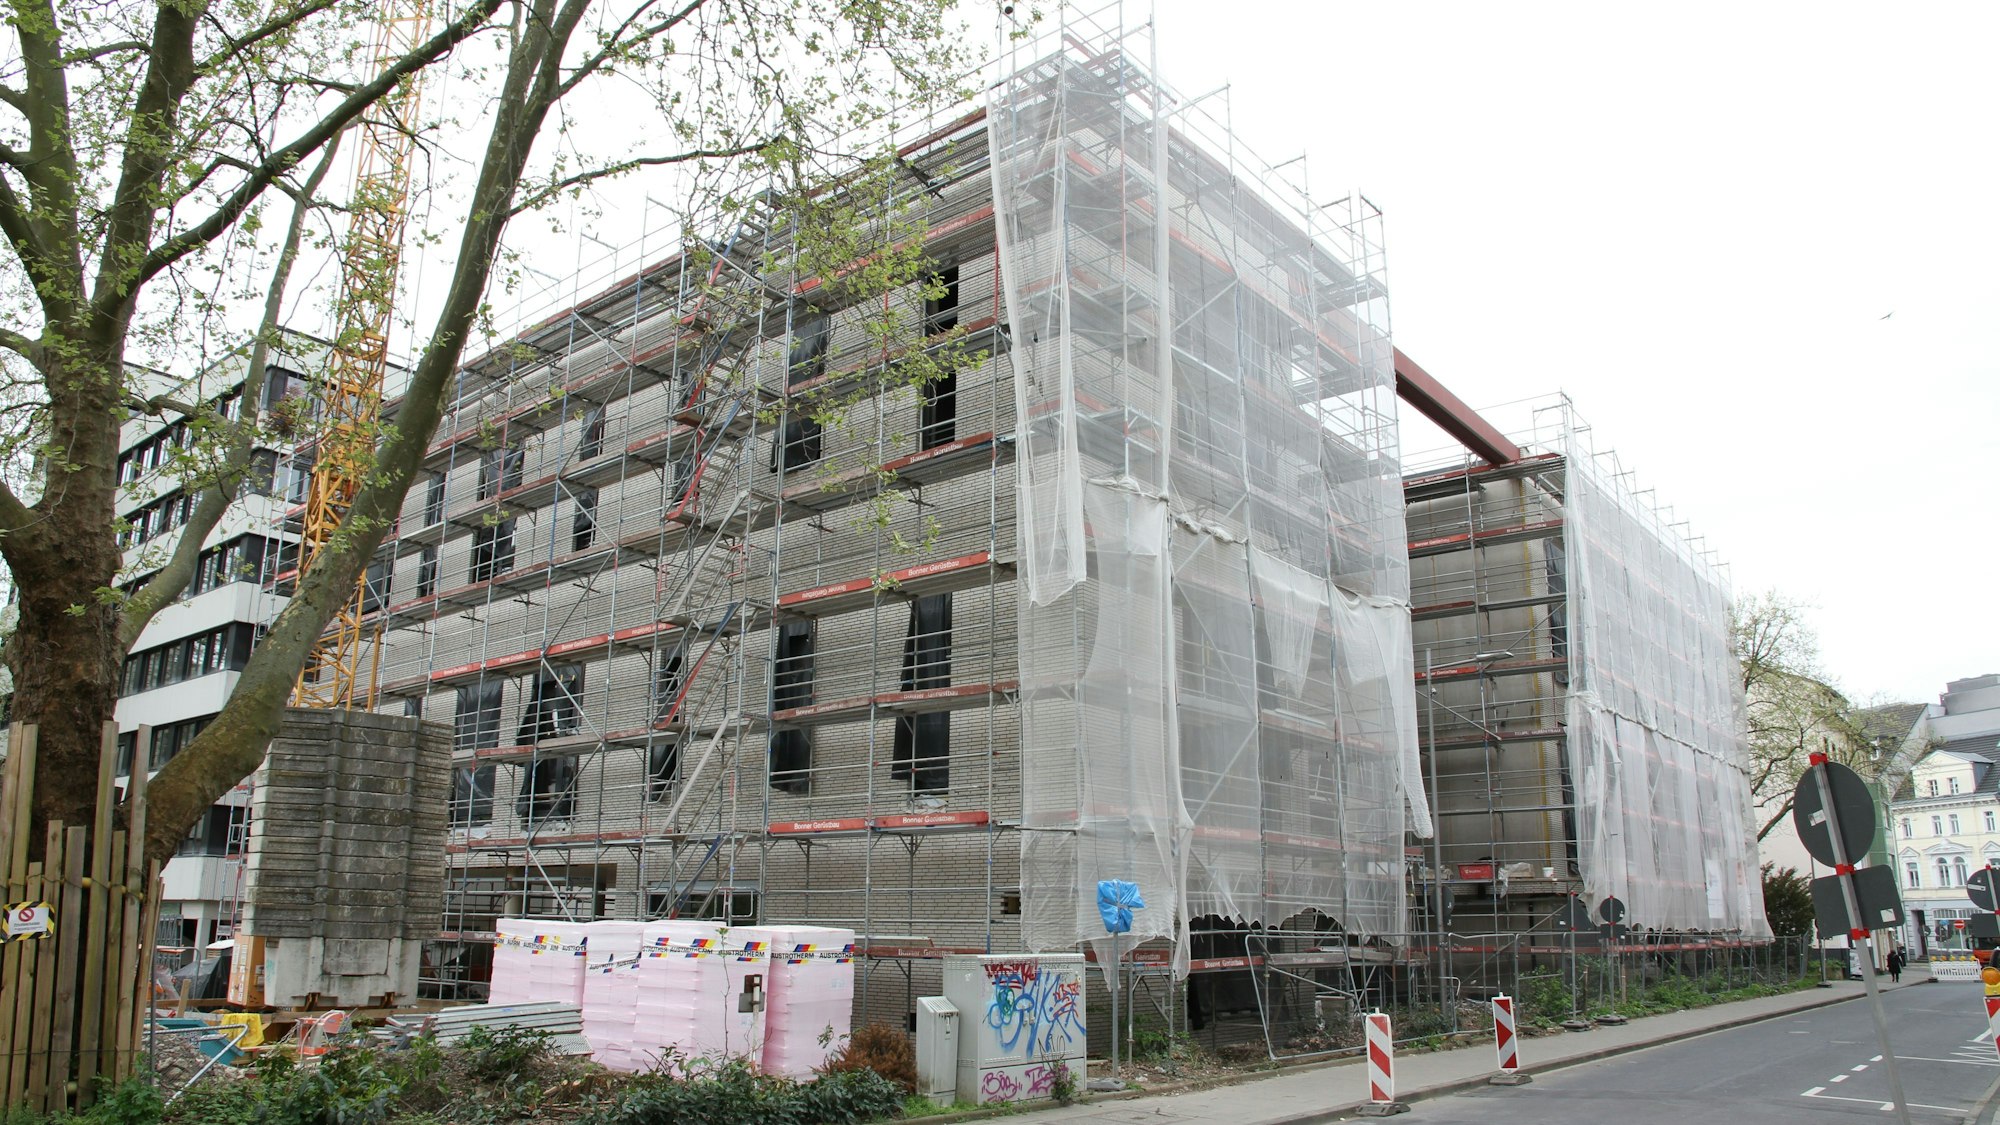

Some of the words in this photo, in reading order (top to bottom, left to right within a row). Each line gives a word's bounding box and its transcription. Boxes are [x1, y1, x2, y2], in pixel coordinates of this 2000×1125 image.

[908, 566, 929, 576] Bonner
[930, 560, 960, 573] Gerüstbau
[794, 822, 813, 830] Bonner
[813, 820, 840, 829] Gerüstbau
[771, 952, 815, 960] AUSTROTHERM
